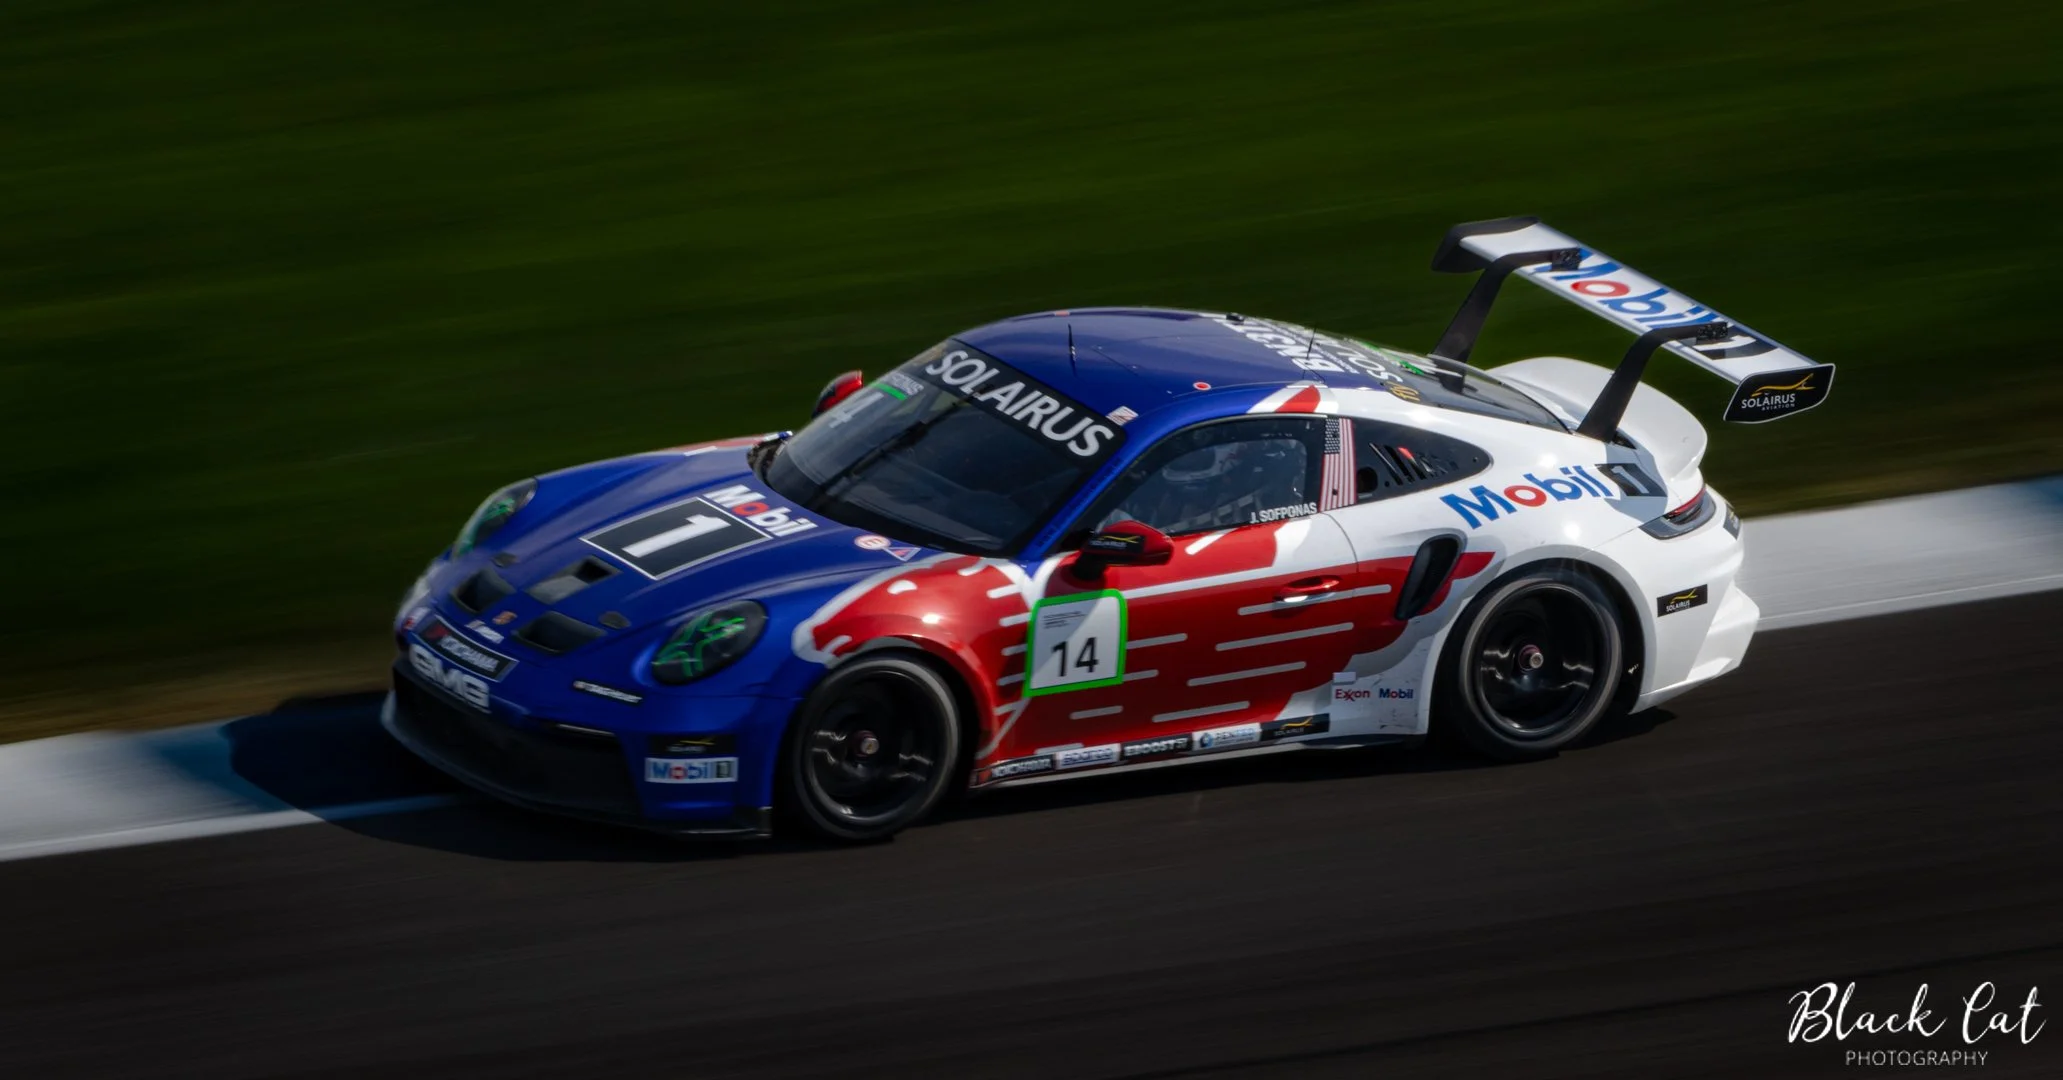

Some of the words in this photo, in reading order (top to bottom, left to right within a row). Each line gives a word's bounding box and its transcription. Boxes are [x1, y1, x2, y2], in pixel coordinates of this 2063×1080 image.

[925, 350, 1115, 457] SOLAIRUS
[1741, 393, 1796, 409] SOLAIRUS
[703, 484, 818, 537] Mobil
[1439, 465, 1614, 530] Mobil
[1611, 465, 1650, 494] 1
[622, 513, 732, 558] 1
[1050, 637, 1098, 677] 14
[1335, 689, 1370, 702] Exxon
[1379, 688, 1414, 699] Mobil
